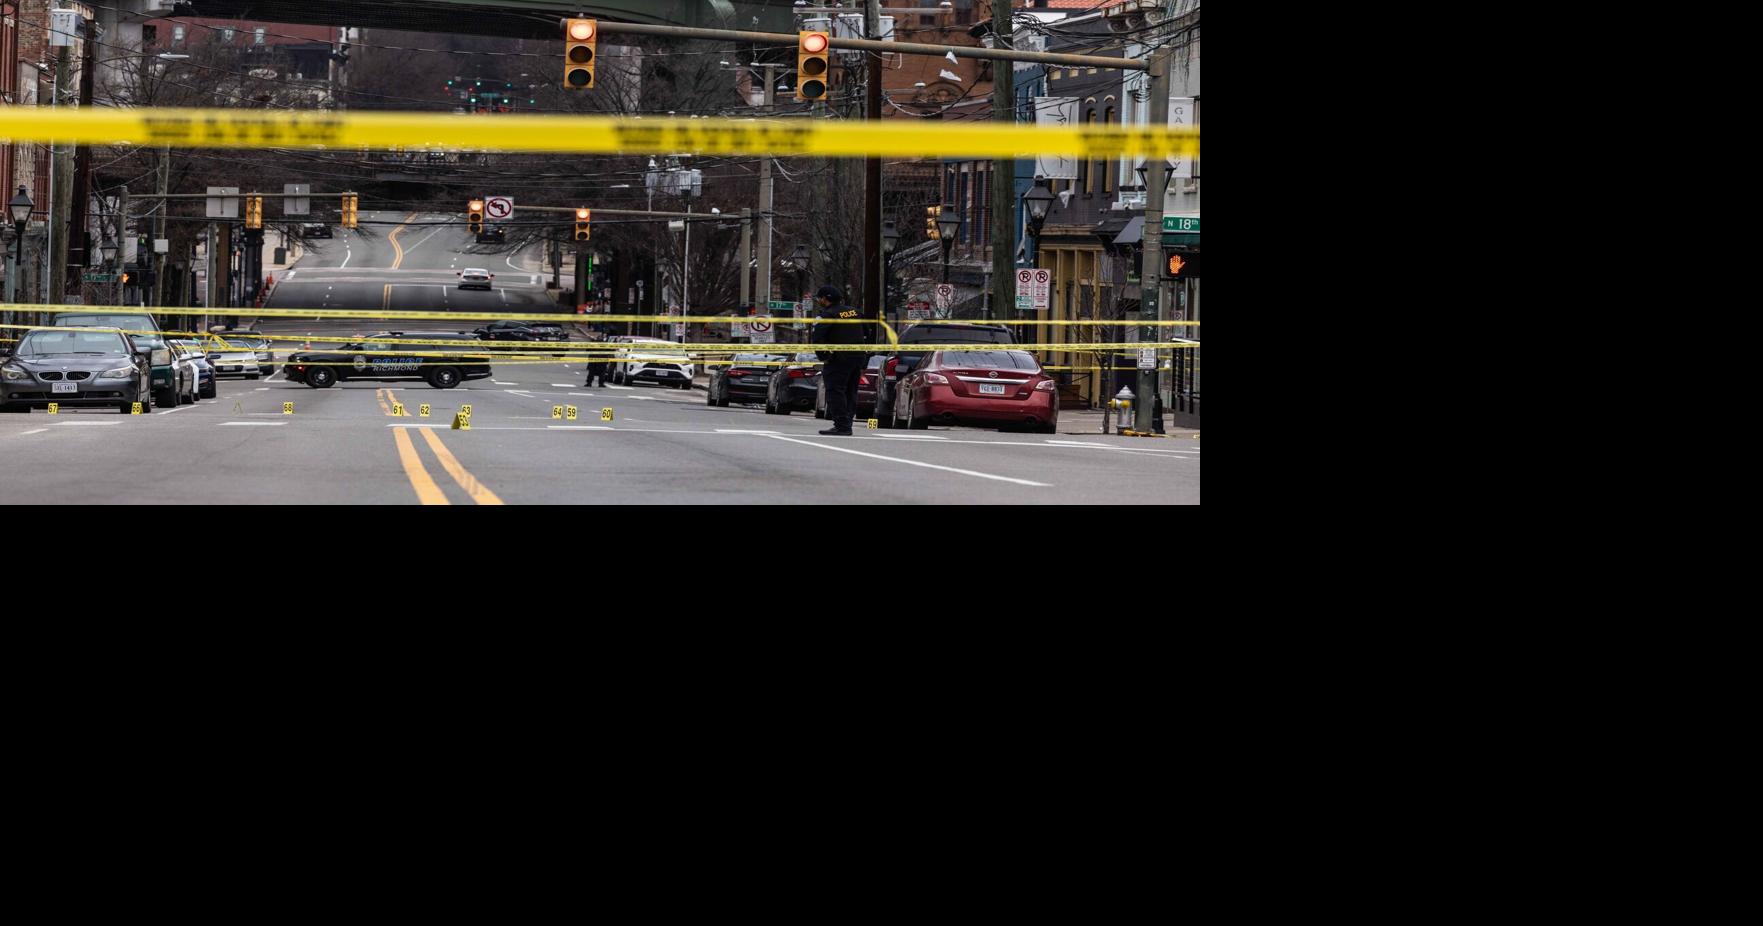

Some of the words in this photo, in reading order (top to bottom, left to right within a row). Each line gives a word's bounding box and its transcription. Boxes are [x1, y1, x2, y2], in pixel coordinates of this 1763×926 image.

[1179, 218, 1199, 230] 18th
[839, 309, 858, 319] POLICE
[372, 357, 423, 366] POLICE
[372, 364, 419, 372] RICHMOND
[48, 404, 57, 413] 67
[393, 405, 403, 415] 61
[420, 406, 430, 415] 62
[462, 406, 471, 415] 63
[553, 407, 562, 416] 64
[567, 407, 576, 417] 59
[602, 409, 611, 418] 60
[868, 420, 877, 429] 69
